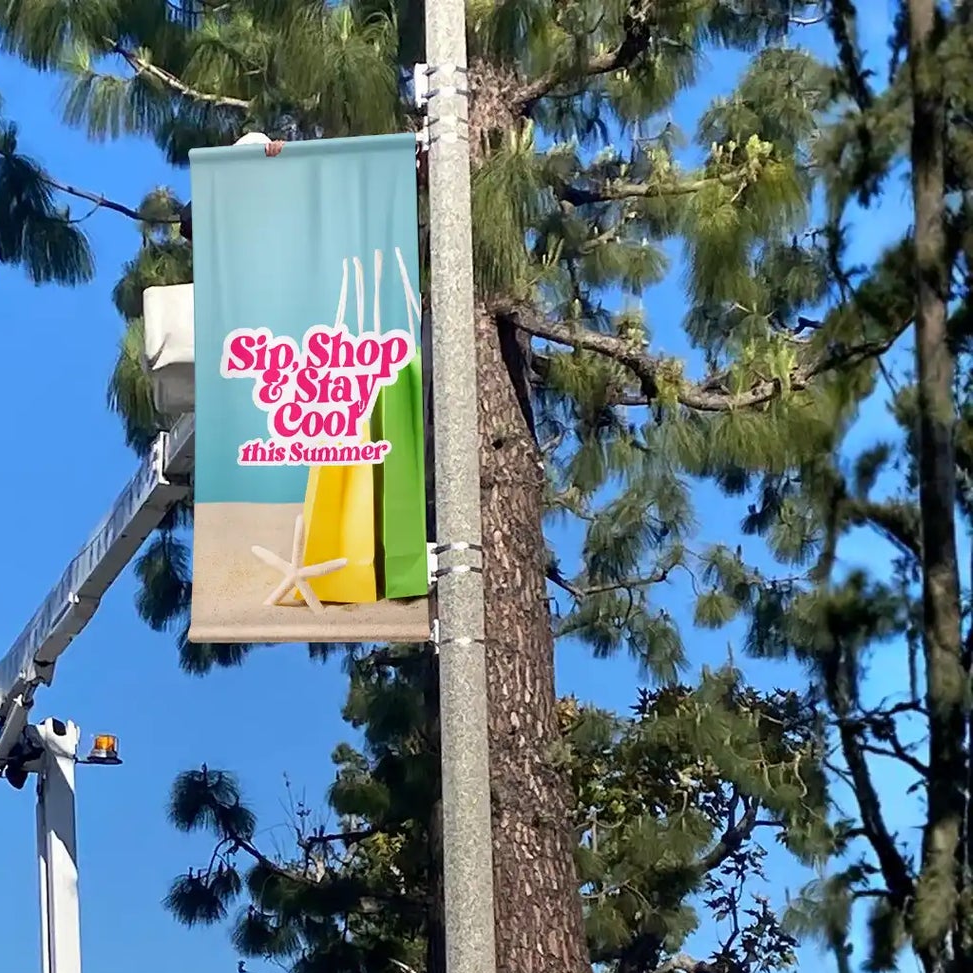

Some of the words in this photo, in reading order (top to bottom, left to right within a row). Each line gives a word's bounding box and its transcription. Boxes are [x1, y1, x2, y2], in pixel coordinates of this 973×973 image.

[227, 334, 299, 376] Sip,
[306, 332, 408, 377] Shop
[259, 368, 289, 404] &
[294, 367, 378, 420] Stay
[273, 402, 361, 438] Cool
[241, 442, 286, 462] this
[289, 442, 388, 462] Summer
